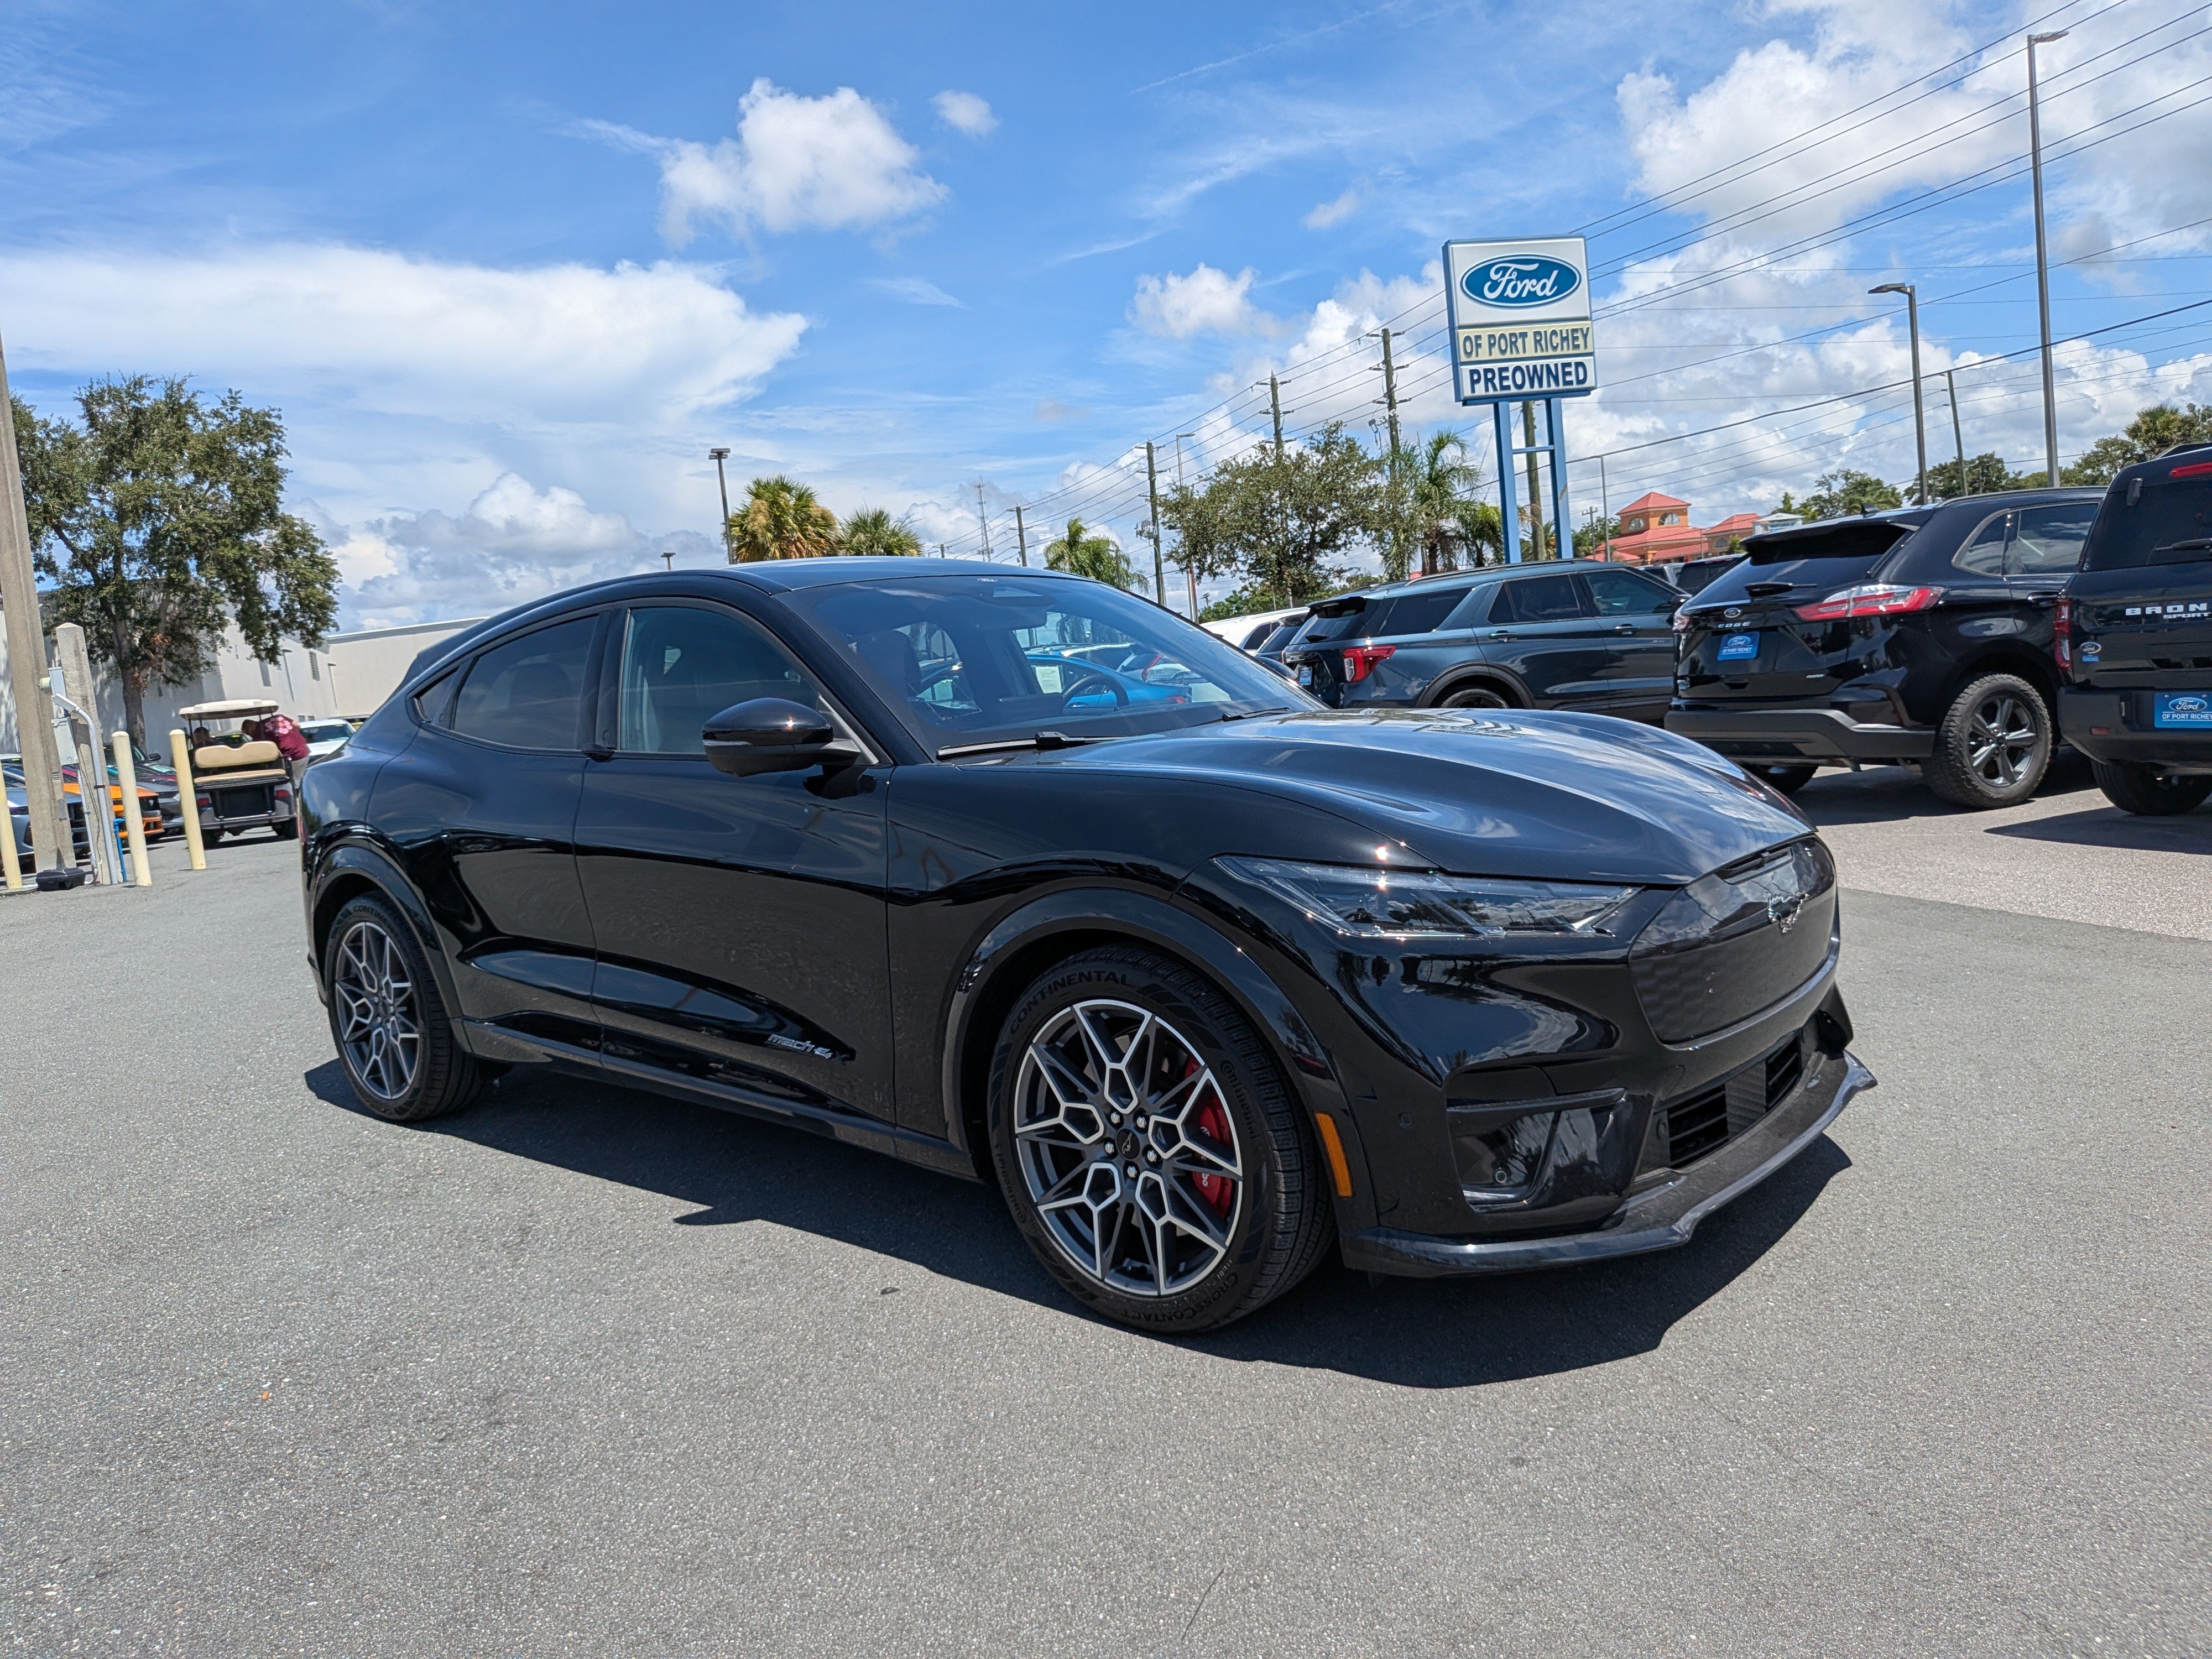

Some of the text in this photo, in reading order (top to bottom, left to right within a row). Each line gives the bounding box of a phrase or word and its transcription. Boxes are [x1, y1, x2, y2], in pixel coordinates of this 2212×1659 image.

[1483, 263, 1559, 299] Ford
[1463, 326, 1590, 359] OF PORT RICHEY
[1469, 361, 1588, 394] PREOWNED
[2176, 699, 2200, 710] Ford
[1010, 969, 1131, 1035] CONTINENTAL
